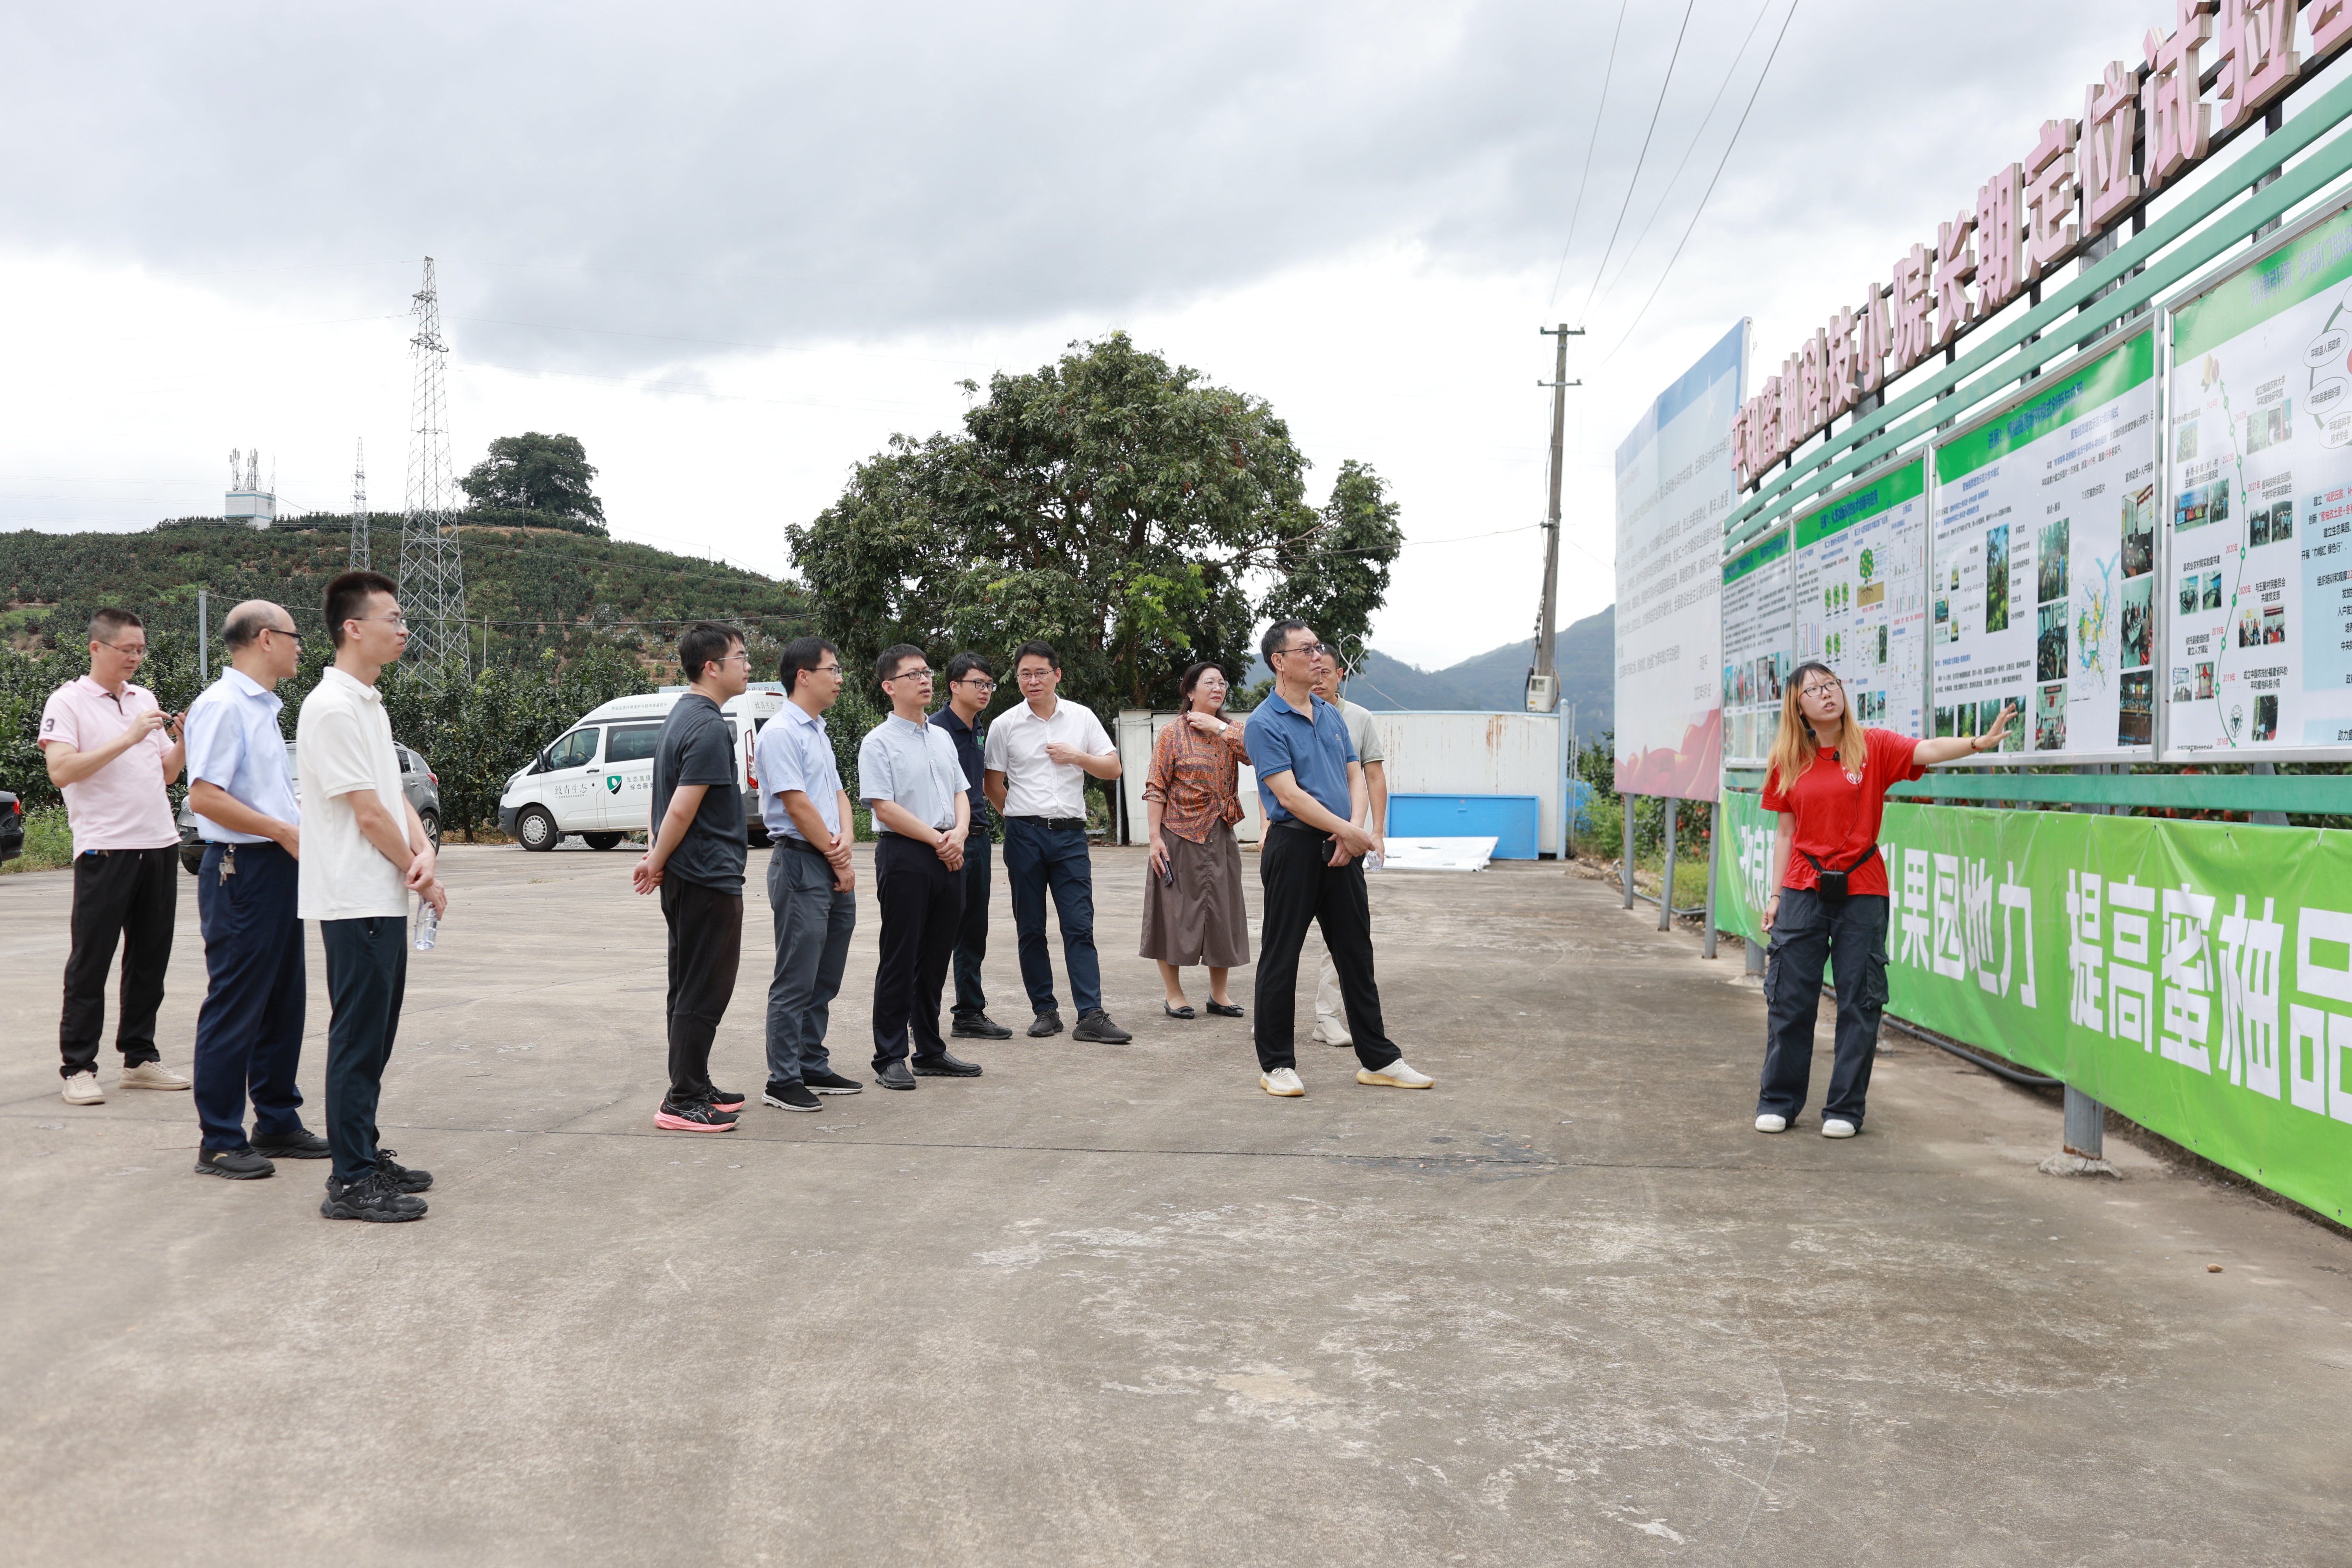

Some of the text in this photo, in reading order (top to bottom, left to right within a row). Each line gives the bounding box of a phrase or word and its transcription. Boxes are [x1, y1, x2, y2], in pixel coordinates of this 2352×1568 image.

[2250, 260, 2293, 308] 党建引领
[2311, 337, 2341, 359] 平和县人民政府
[2255, 375, 2285, 396] 成立福建农林大学
[2257, 388, 2283, 407] 平和蜜柚研究院
[2311, 385, 2341, 406] 平和县委组织部
[2207, 398, 2218, 410] 2024年
[2235, 411, 2247, 422] 2022年
[2329, 415, 2351, 432] 平和县科学
[2331, 430, 2348, 444] 技术协会
[2222, 453, 2235, 464] 2022年
[2248, 480, 2260, 492] 2021年
[2261, 483, 2292, 501] 产教学研深度融合
[2226, 543, 2238, 554] 2020年
[2183, 554, 2220, 572] 县农业农村局实验室共建
[2239, 585, 2251, 595] 2020年
[2255, 577, 2286, 593] 与五星村民委员会
[2261, 591, 2281, 603] 共建党支部
[2342, 587, 2352, 599] 发放
[2212, 626, 2224, 636] 2019年
[2186, 633, 2210, 645] 依托县委组织部
[2223, 673, 2236, 682] 2019年
[2244, 666, 2288, 679] 成立中国农技协福建省科协
[2251, 679, 2280, 691] 平和蜜柚科技小院
[43, 718, 55, 732] 3
[627, 775, 653, 783] 生态高值
[555, 783, 587, 795] 致青生态
